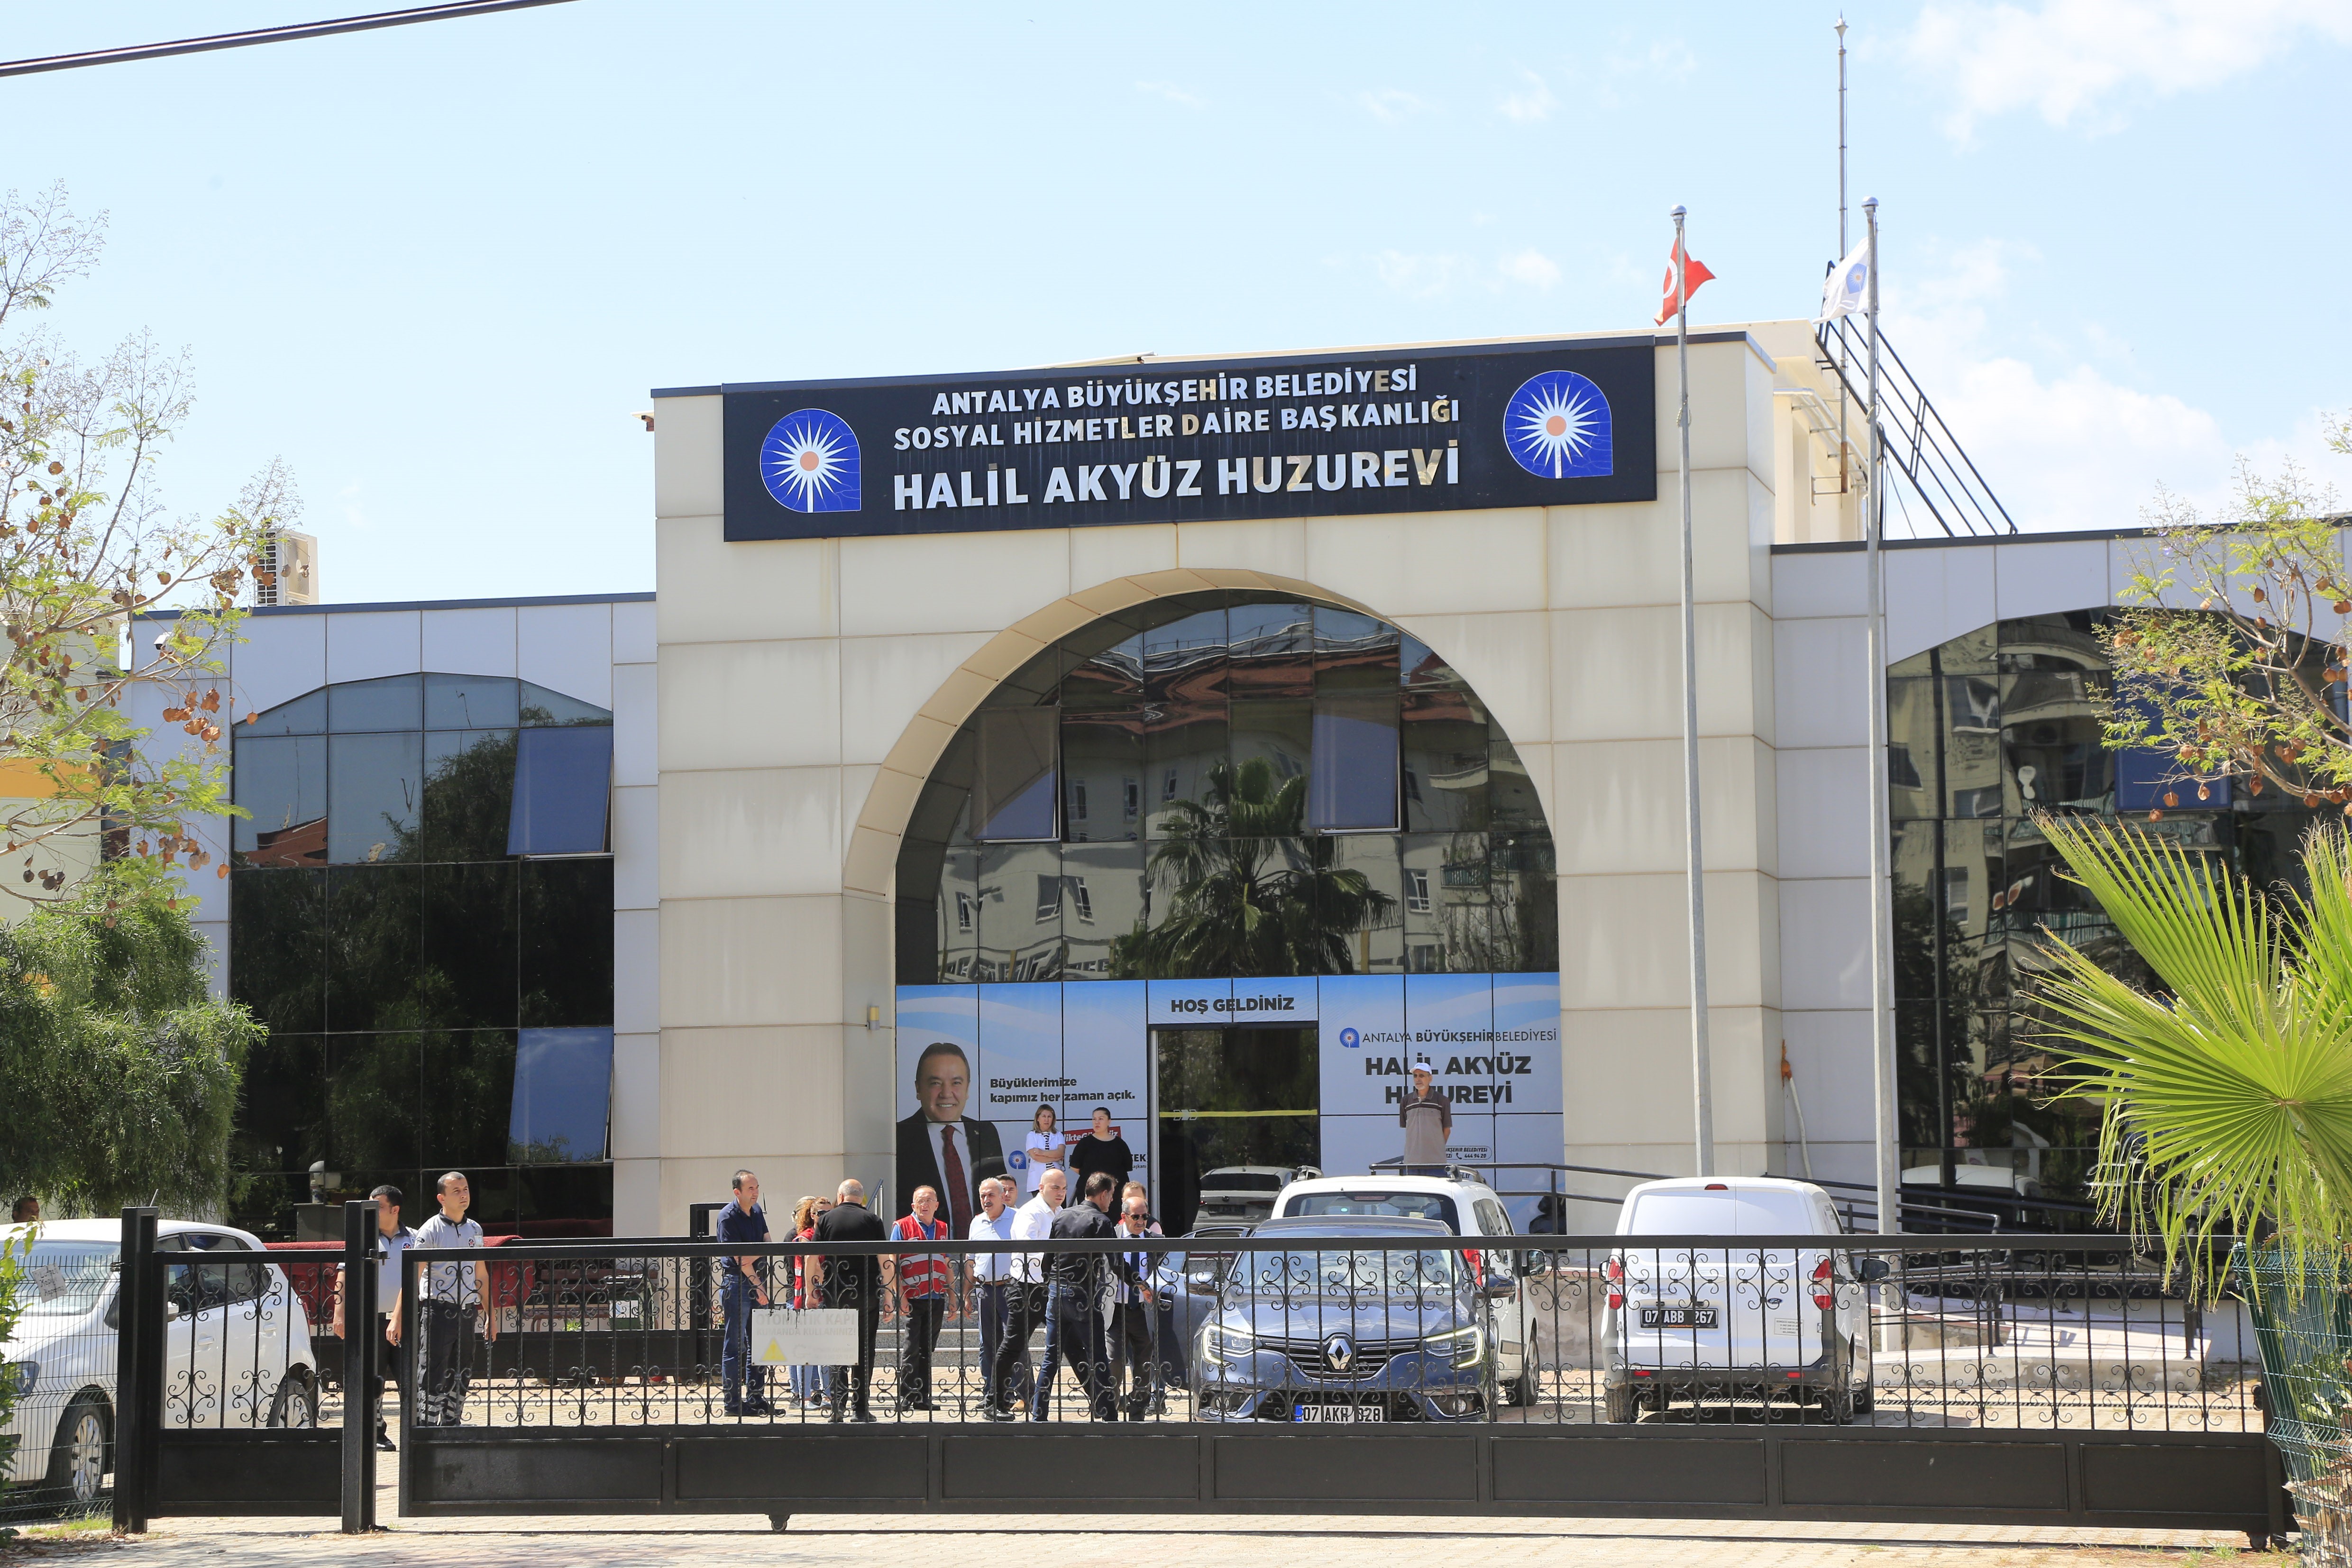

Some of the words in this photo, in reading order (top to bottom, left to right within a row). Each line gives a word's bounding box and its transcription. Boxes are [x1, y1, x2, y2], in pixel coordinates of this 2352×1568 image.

[931, 387, 1061, 415] ANTALYA
[1067, 372, 1249, 408] BÜYÜKŞEHİR
[1255, 364, 1416, 399] BELEDİYESİ
[893, 424, 1004, 450] SOSYAL
[1014, 413, 1174, 445] HİZMETLER
[1181, 404, 1270, 436] DAİRE
[1281, 394, 1459, 432] BAŞKANLIĞI
[894, 463, 1028, 511] HALİL
[1043, 455, 1202, 504] AKYÜZ
[1217, 439, 1458, 495] HUZUREVİ
[1171, 999, 1208, 1014] HOŞ
[1213, 994, 1295, 1012] GELDİNİZ
[1362, 1032, 1412, 1043] ANTALYA
[1416, 1029, 1493, 1045] BÜYÜKŞEHİR
[1495, 1028, 1556, 1042] BELEDİYESİ
[1445, 1052, 1532, 1075] AKYÜZ
[990, 1078, 1077, 1090] Büyüklerimize
[1385, 1081, 1512, 1104] HUREVİ
[990, 1093, 1038, 1104] kapımız
[1041, 1092, 1061, 1102] her
[1064, 1092, 1104, 1101] zaman
[1107, 1090, 1135, 1101] açık.
[826, 1313, 855, 1325] KAPI
[1645, 1310, 1659, 1323] 07
[1664, 1310, 1684, 1323] ABB
[1695, 1311, 1714, 1324] 267
[757, 1328, 801, 1336] KUMANDA
[1304, 1407, 1319, 1421] 07
